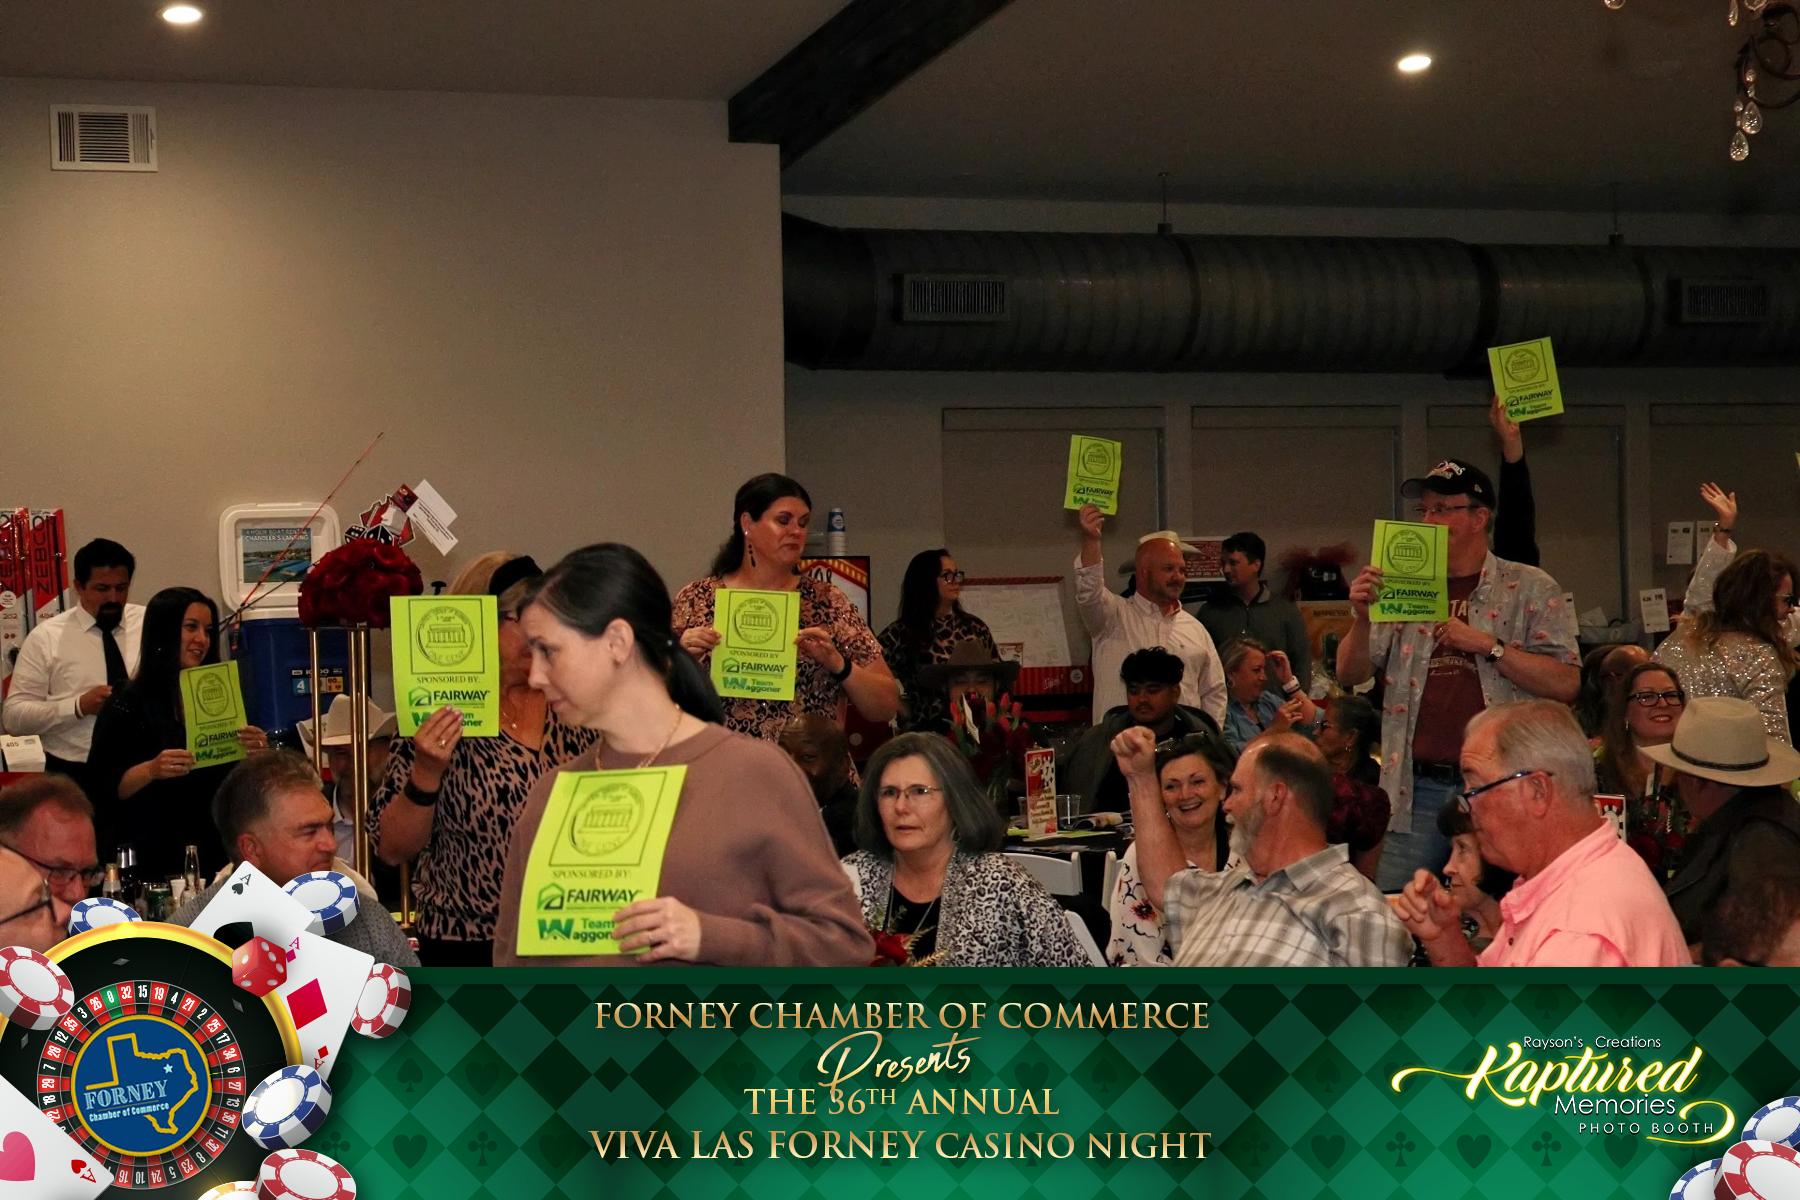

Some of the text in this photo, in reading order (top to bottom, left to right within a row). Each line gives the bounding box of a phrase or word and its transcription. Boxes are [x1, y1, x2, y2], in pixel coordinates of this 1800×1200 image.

[1396, 589, 1439, 599] FAIRWAY
[741, 662, 785, 672] FAIRWAY
[433, 690, 488, 700] FAIRWAY
[552, 870, 613, 879] SPONSORED
[566, 889, 641, 902] FAIRWAY
